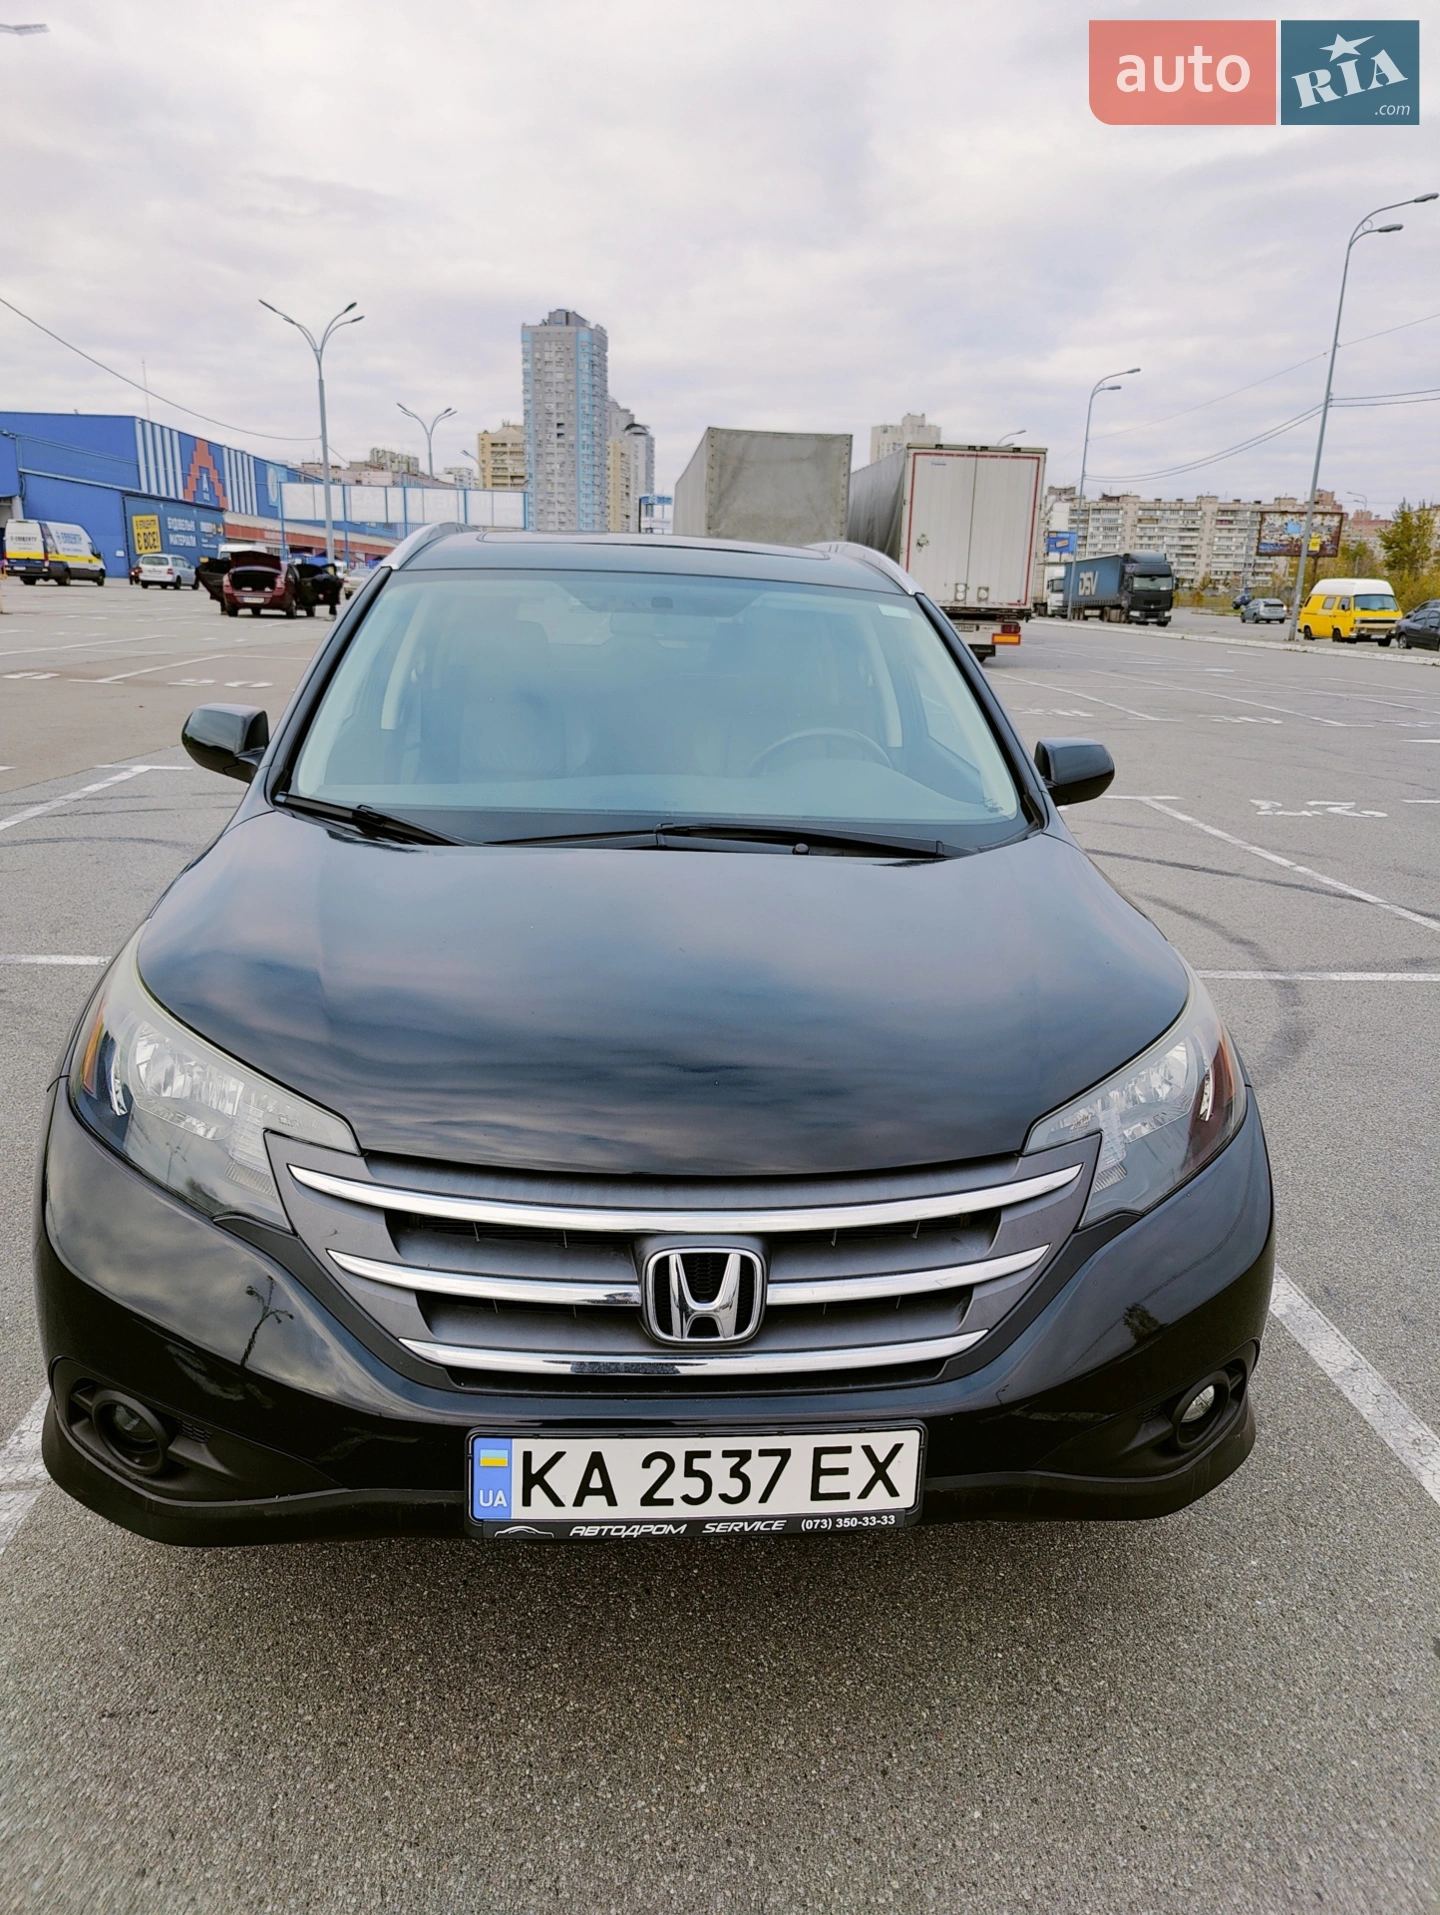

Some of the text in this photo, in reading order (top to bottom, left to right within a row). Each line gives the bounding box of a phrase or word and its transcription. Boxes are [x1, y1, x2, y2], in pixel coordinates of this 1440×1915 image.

[1078, 571, 1099, 596] DSV
[521, 1442, 905, 1508] KA 2537 EX
[479, 1489, 508, 1508] UA
[569, 1514, 896, 1538] АВТОДРОМ SERVICE (073) 350-33-33
